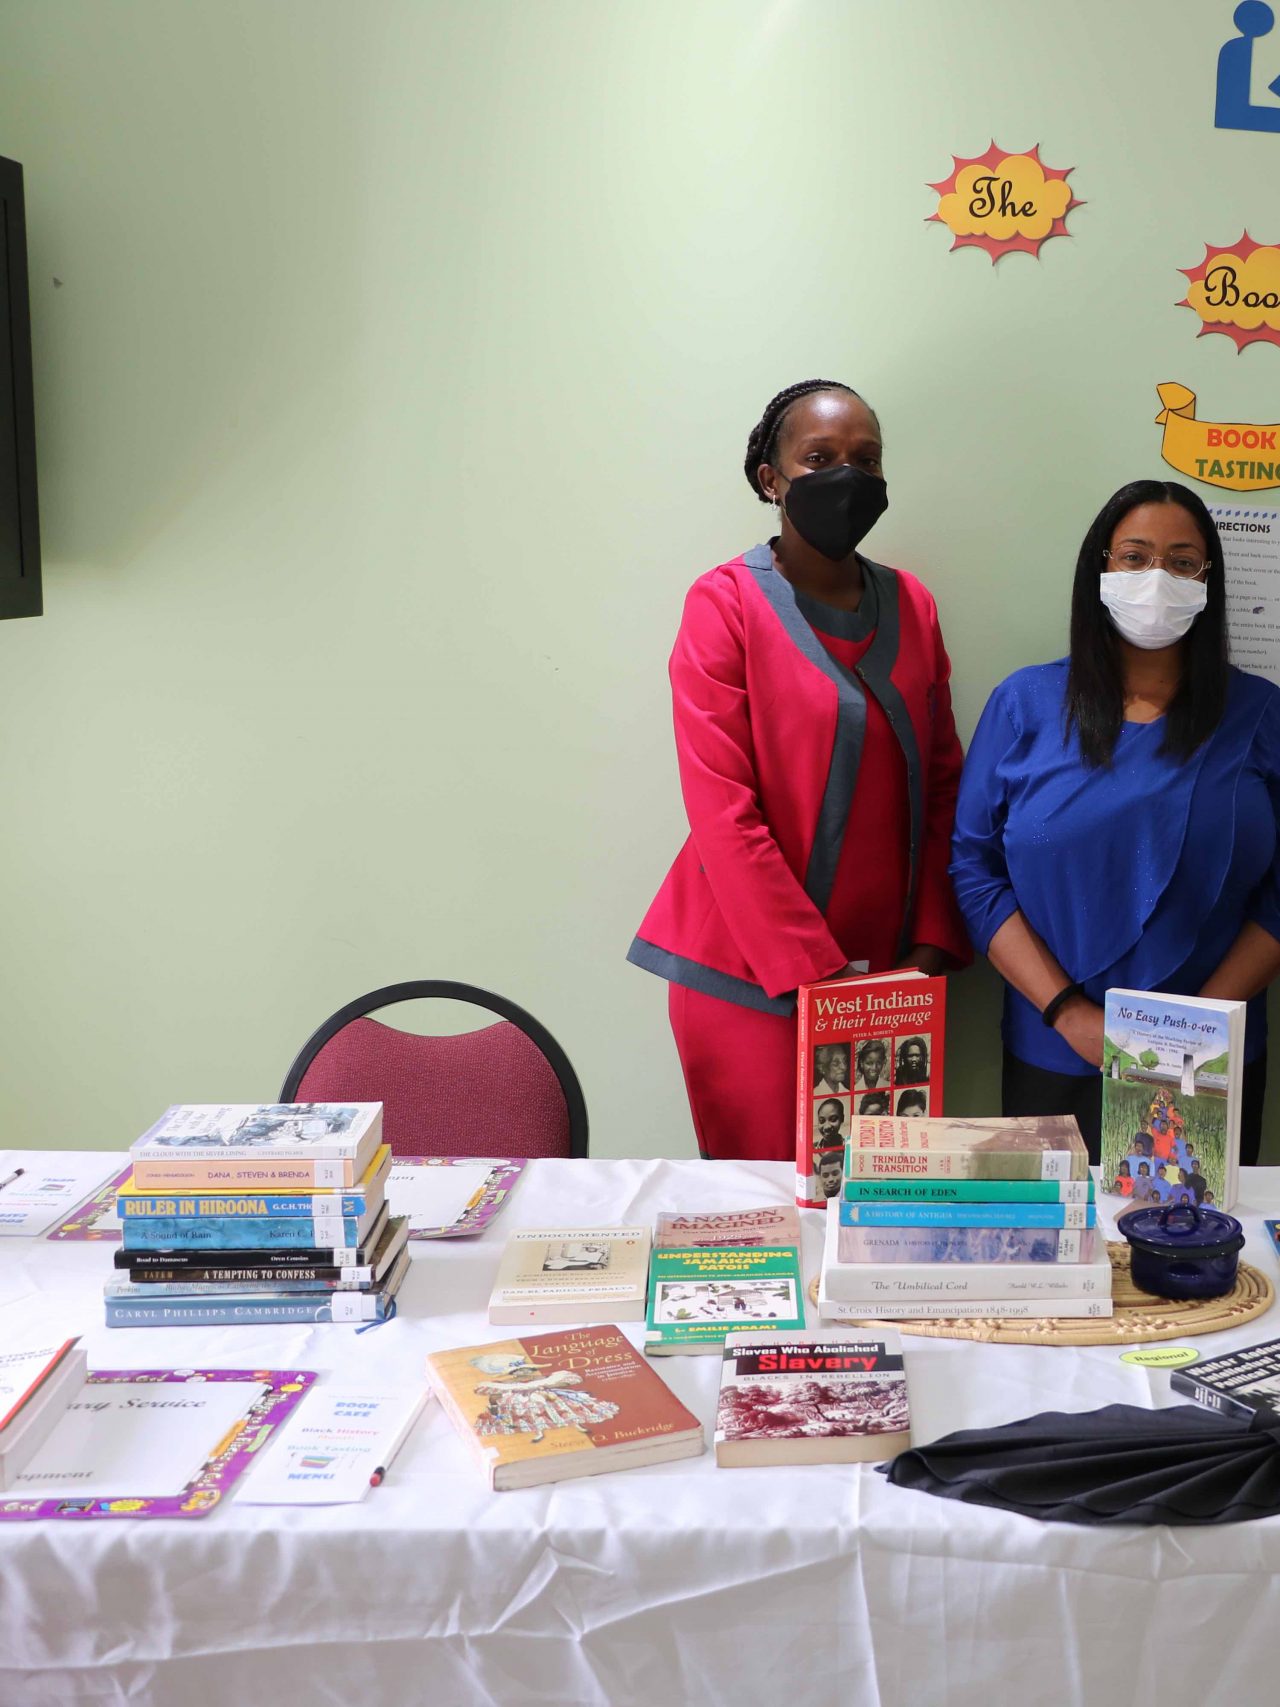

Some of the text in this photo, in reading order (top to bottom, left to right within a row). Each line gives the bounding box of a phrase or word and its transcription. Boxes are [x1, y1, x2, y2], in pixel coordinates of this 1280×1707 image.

[968, 176, 1037, 218] The
[1207, 428, 1277, 450] BOOK
[1215, 521, 1271, 534] IRECTIONS
[815, 990, 934, 1016] West Indians
[815, 1010, 932, 1032] & their language
[1118, 1007, 1218, 1034] No Easy Push-o-ver
[872, 1155, 928, 1164] TRINIDAD IN
[237, 1171, 310, 1179] STEVEN & BRENDA
[872, 1164, 928, 1173] TRANSITION
[859, 1187, 957, 1196] IN SEARCH OF EDEN
[125, 1199, 268, 1216] RULER IN HIROONA
[690, 1210, 778, 1223] NATION
[917, 1211, 953, 1219] ANTIGUA
[671, 1216, 785, 1230] IMAGINED
[141, 1229, 295, 1239] A Sound of Rain Karen
[516, 1231, 641, 1239] UNDOCUMENTED
[657, 1251, 793, 1260] UNDERSTANDING
[203, 1270, 316, 1280] A TEMPTING TO CONFESS
[871, 1281, 968, 1290] The Umbilical Cord
[115, 1306, 313, 1319] CARYL PHILLIPS CAMBRIDGE
[849, 1304, 983, 1315] Croix History and Emancipation
[565, 1332, 592, 1342] The
[530, 1334, 625, 1359] Language
[586, 1349, 596, 1357] of
[732, 1344, 879, 1357] Slaves Who Abolished
[557, 1351, 633, 1370] Dress
[758, 1353, 879, 1372] Slavery
[1134, 1350, 1190, 1364] Regional
[1185, 1357, 1238, 1377] Walter
[1200, 1356, 1276, 1383] Intellectual
[821, 1372, 891, 1380] REBELLION
[1213, 1368, 1271, 1389] Political
[119, 1398, 207, 1409] Service
[337, 1428, 381, 1436] History
[614, 1422, 676, 1441] Buckridge
[324, 1445, 372, 1454] Tasting
